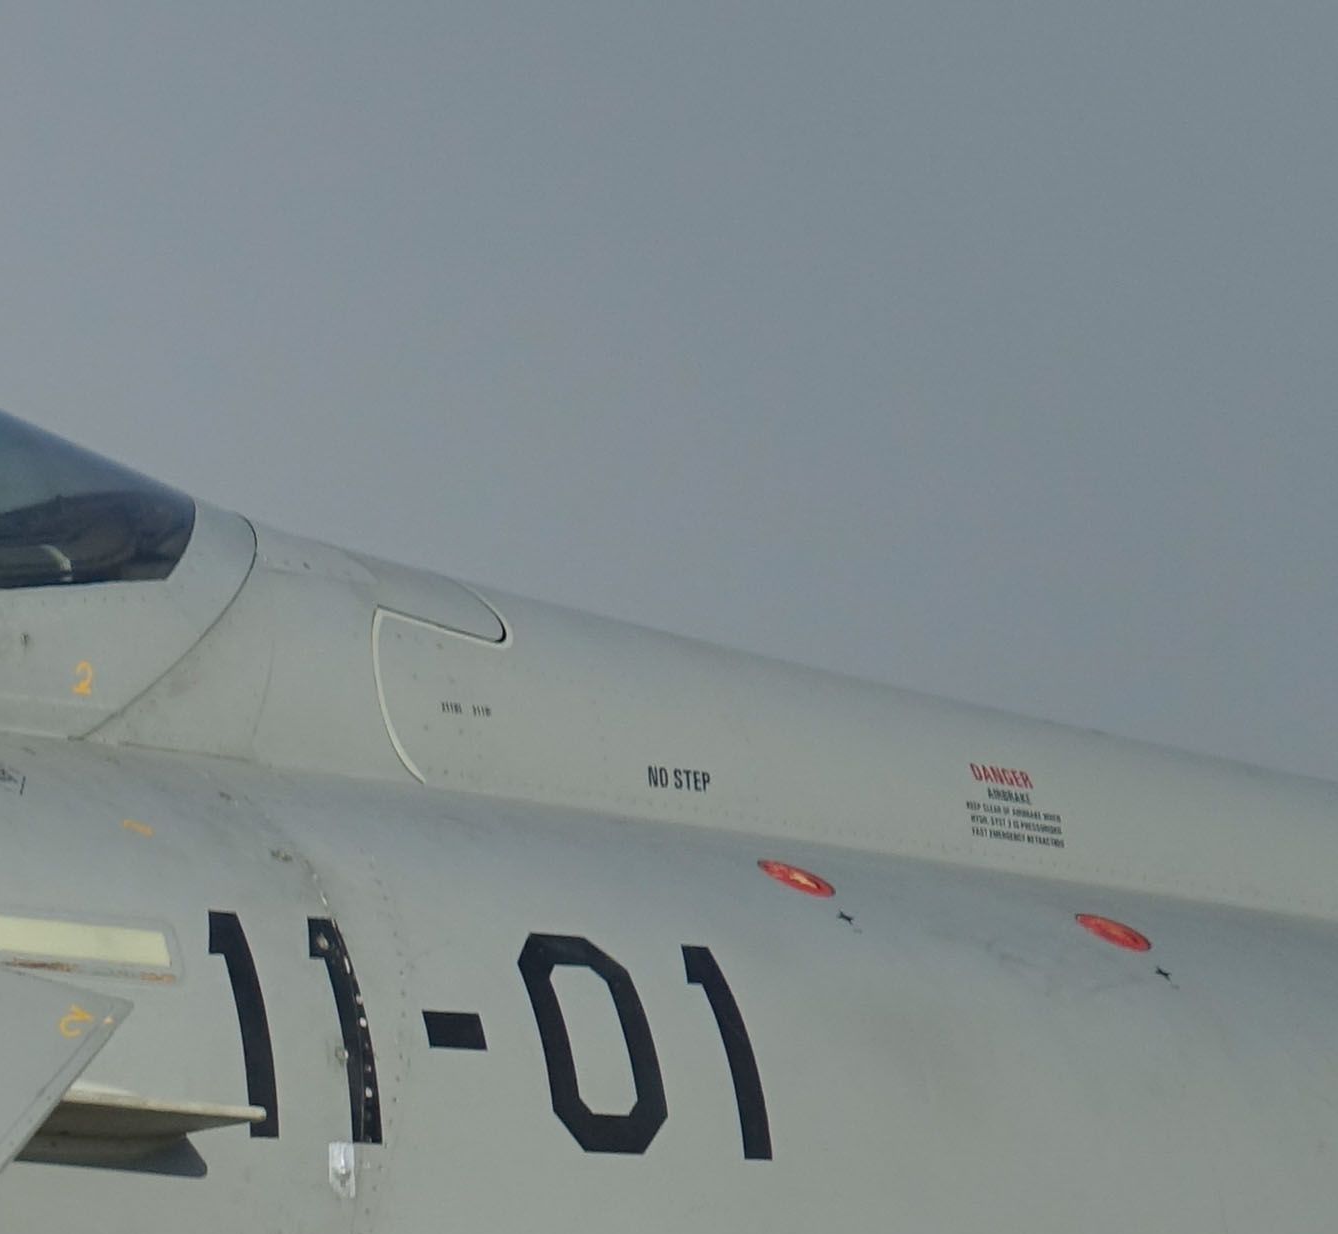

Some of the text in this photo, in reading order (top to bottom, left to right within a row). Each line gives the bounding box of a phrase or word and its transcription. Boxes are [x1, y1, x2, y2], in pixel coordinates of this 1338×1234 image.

[73, 661, 93, 694] 2
[648, 765, 710, 791] NO STEP
[970, 762, 1033, 790] DANGER
[987, 787, 1031, 805] AIRBRAKE
[209, 910, 772, 1160] 11-01
